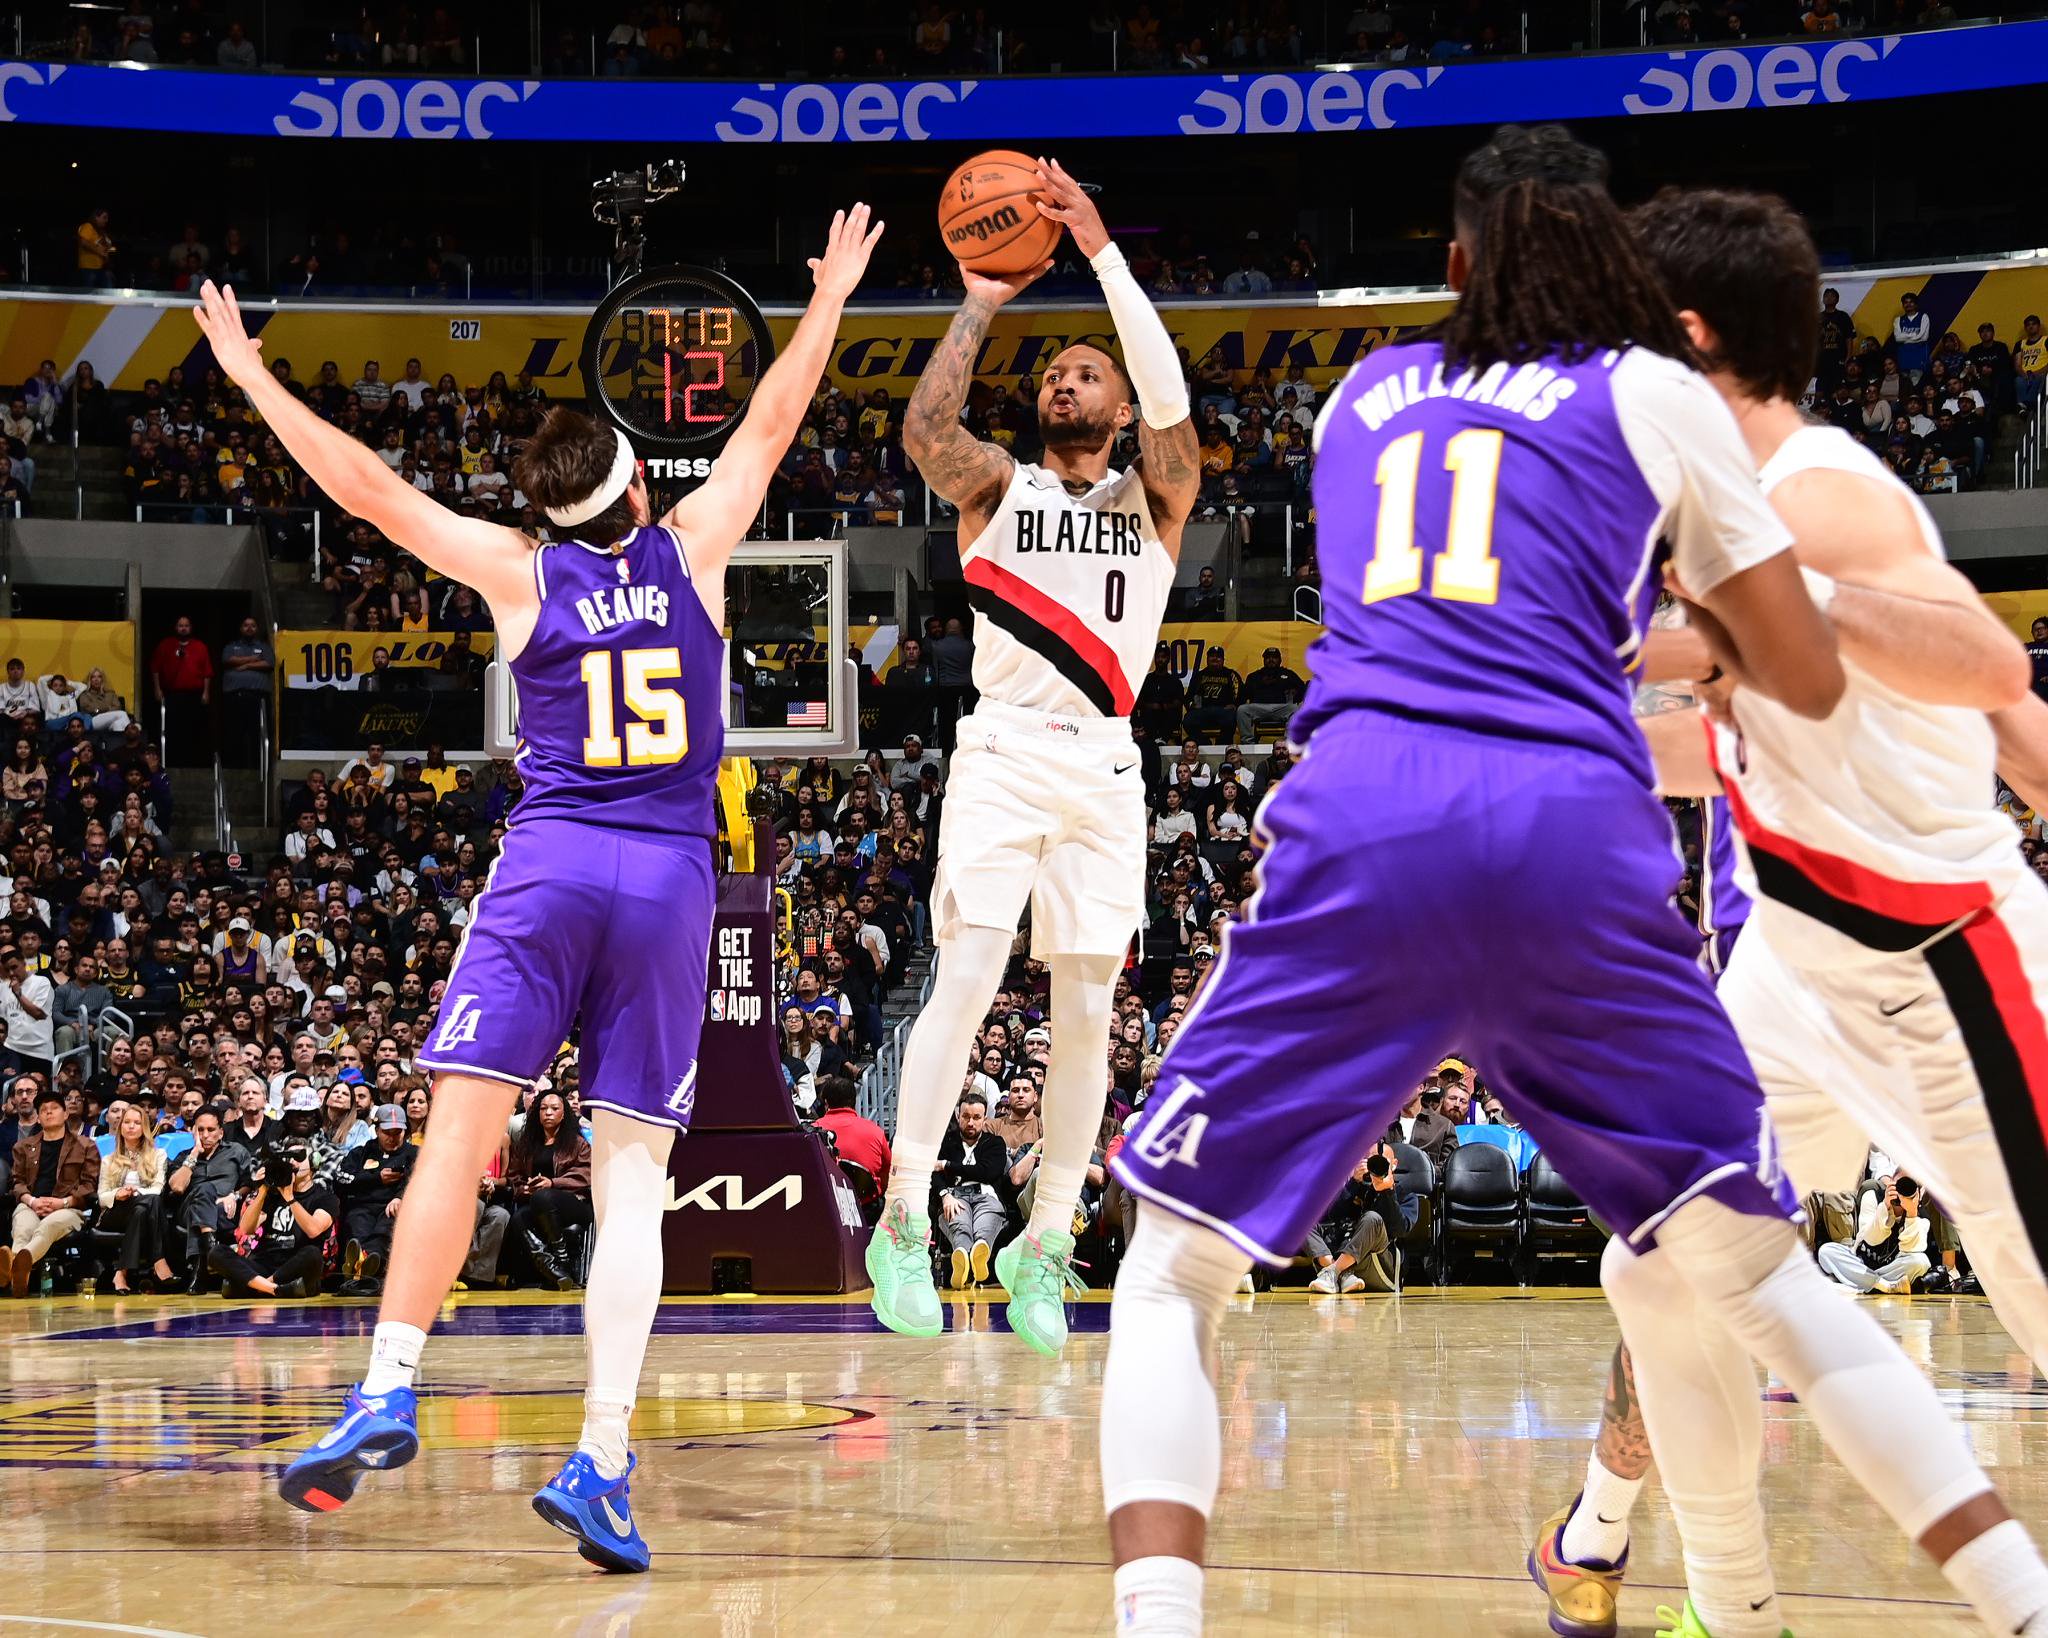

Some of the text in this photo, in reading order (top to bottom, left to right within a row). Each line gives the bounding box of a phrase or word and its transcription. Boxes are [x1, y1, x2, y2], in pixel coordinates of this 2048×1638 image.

[947, 204, 1022, 244] Wilson
[451, 320, 480, 340] 207
[649, 307, 732, 346] 7:13
[663, 350, 725, 423] 12
[1352, 361, 1578, 432] WILLIAMS
[1014, 510, 1142, 556] BLAZERS
[1362, 428, 1504, 605] 11
[575, 585, 669, 635] REAVES
[1105, 569, 1125, 622] 0
[301, 643, 353, 682] 106
[389, 642, 446, 661] LO
[1168, 639, 1205, 679] 07
[580, 647, 689, 767] 15
[719, 928, 752, 957] GET
[719, 959, 753, 987] THE
[432, 994, 481, 1052] LA
[727, 990, 761, 1026] App
[1130, 1074, 1209, 1169] LA
